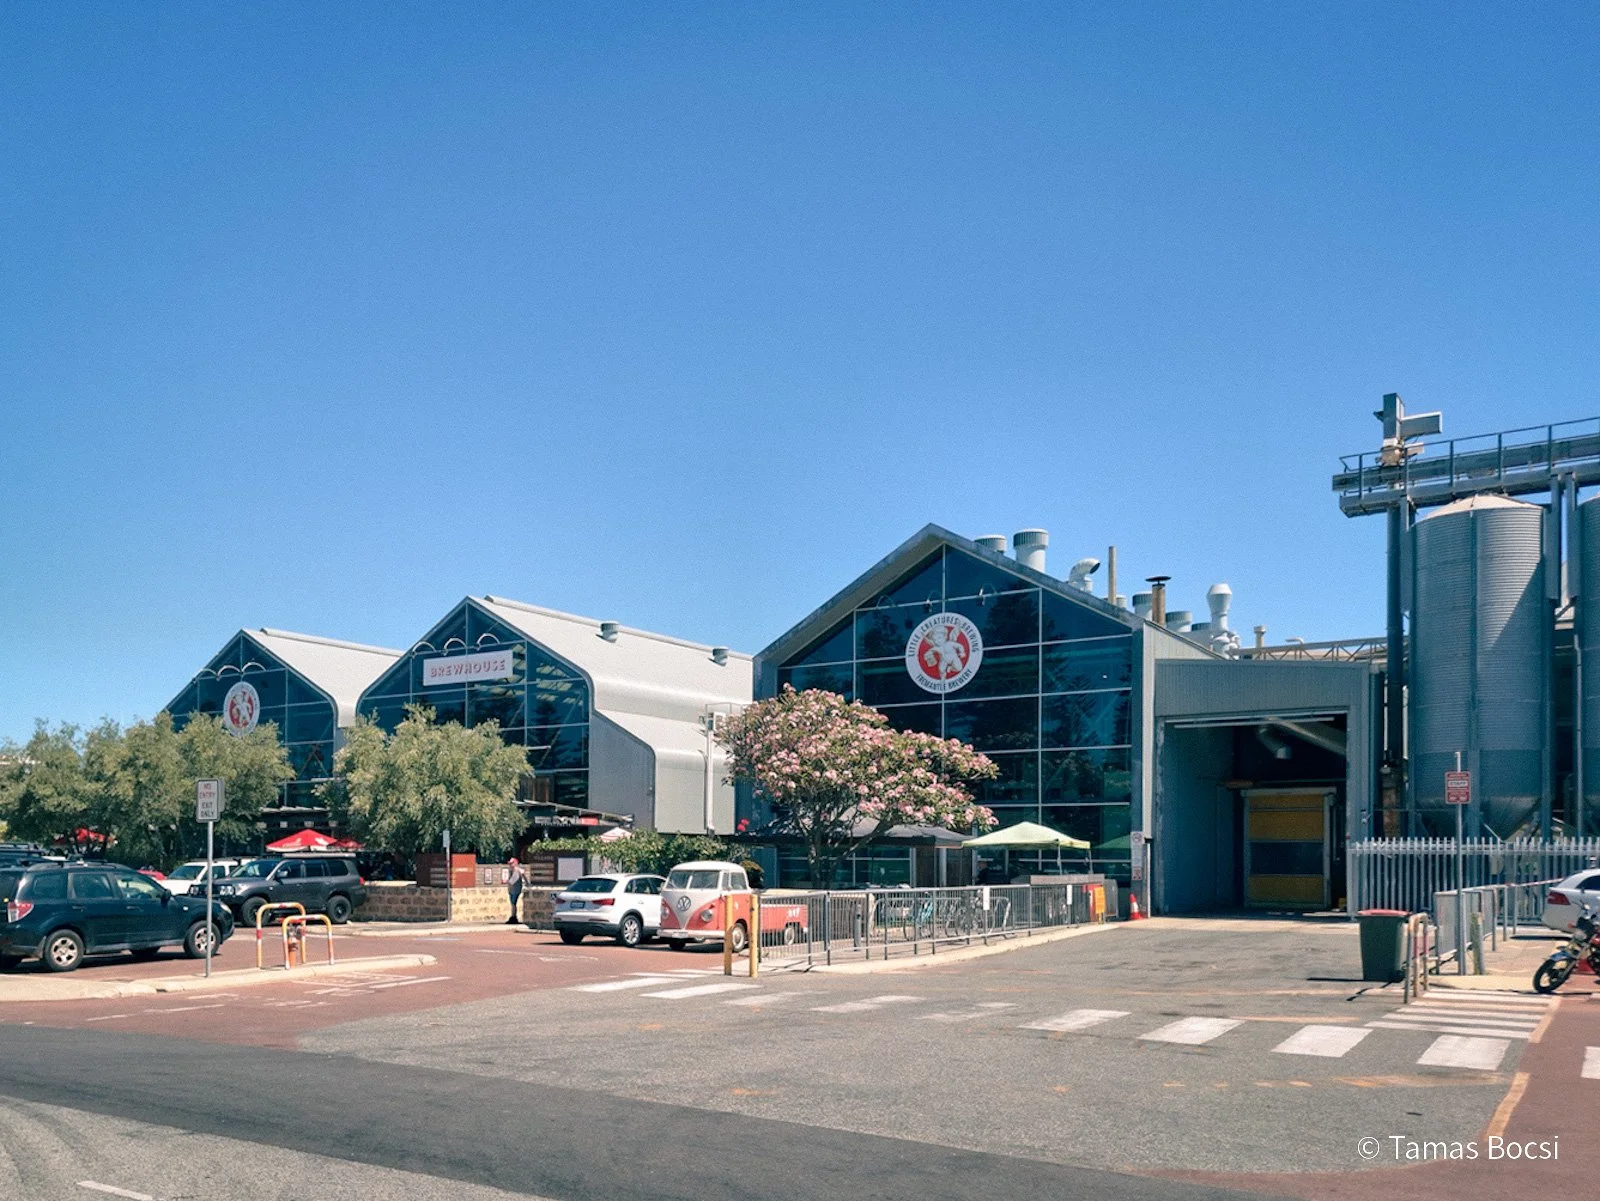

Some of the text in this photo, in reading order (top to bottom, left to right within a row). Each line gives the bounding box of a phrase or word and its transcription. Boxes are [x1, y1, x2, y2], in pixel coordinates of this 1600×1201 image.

[908, 615, 980, 657] LITTLE CREATURES BREWING
[430, 659, 506, 678] BREWHOUSE
[915, 668, 973, 691] FREMANTLE BREWERY
[199, 791, 216, 799] ENTRY
[202, 801, 213, 809] EXIT
